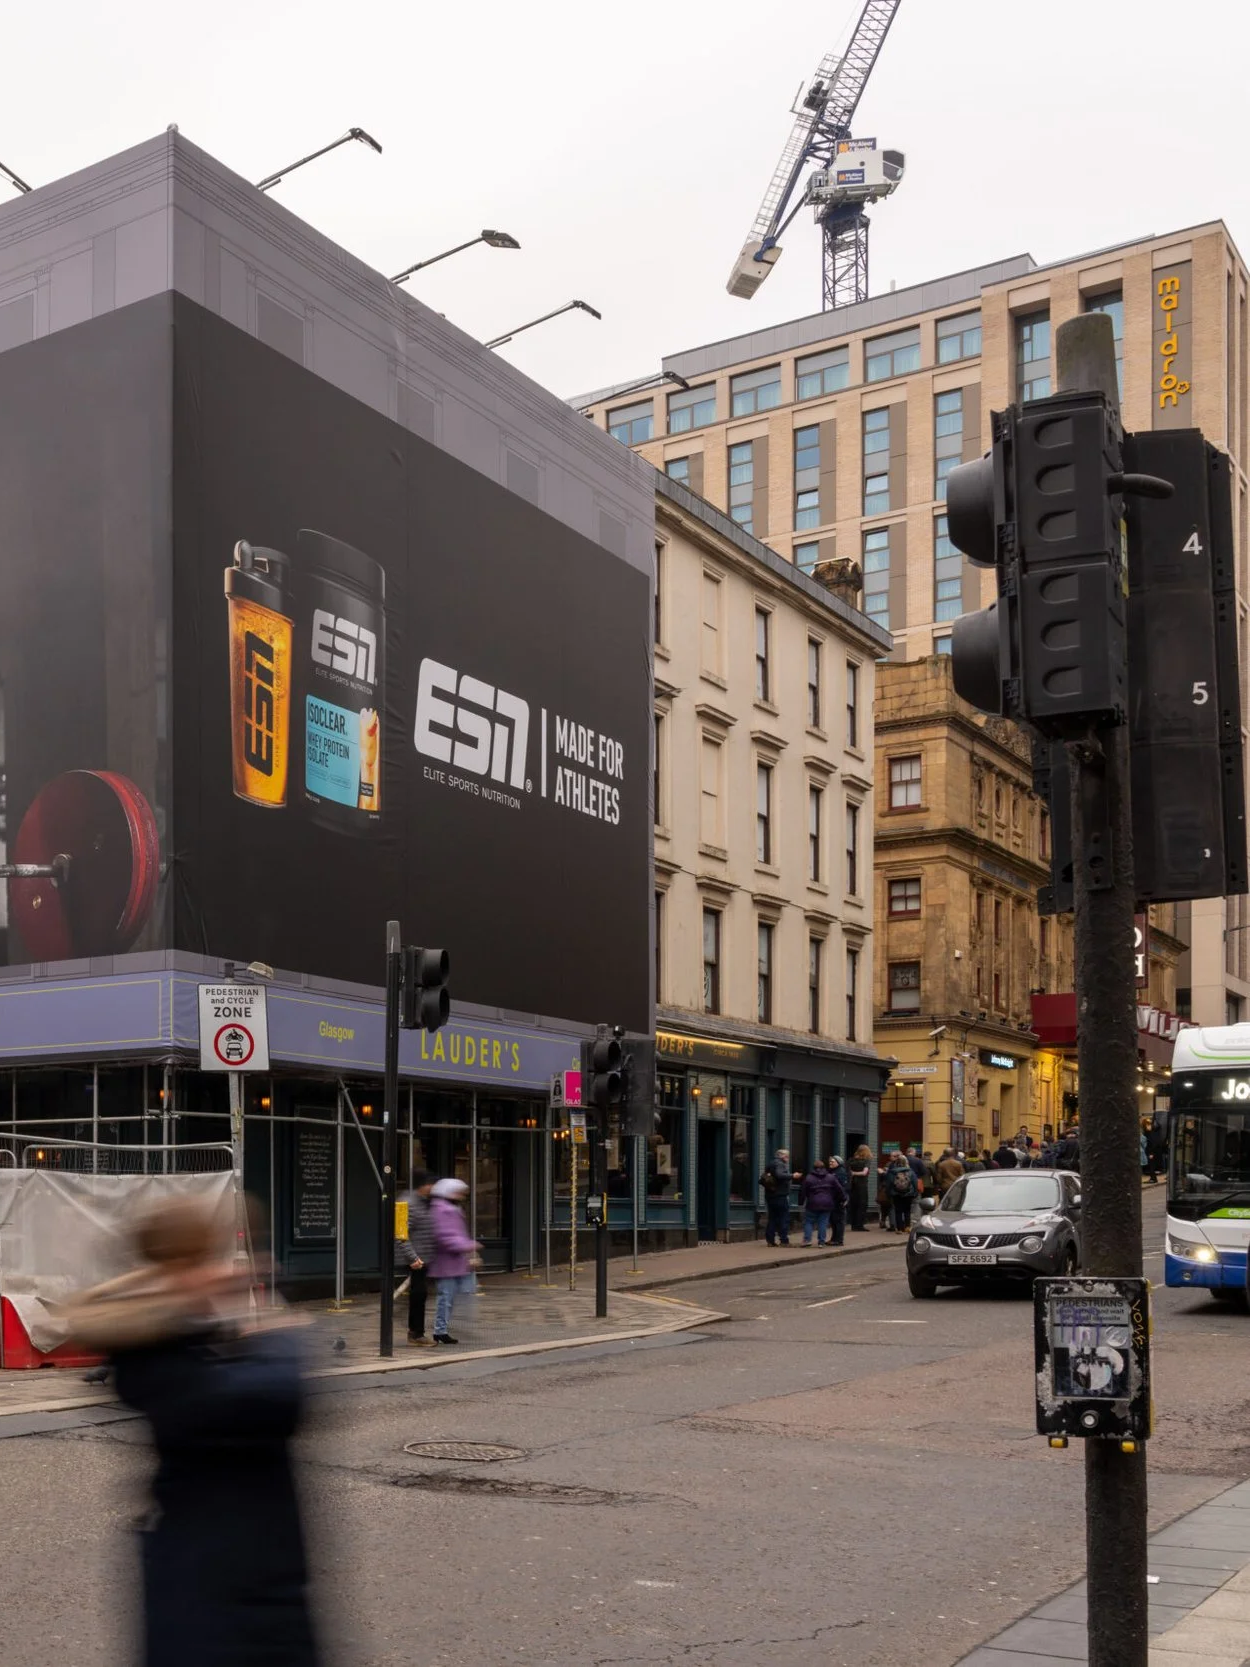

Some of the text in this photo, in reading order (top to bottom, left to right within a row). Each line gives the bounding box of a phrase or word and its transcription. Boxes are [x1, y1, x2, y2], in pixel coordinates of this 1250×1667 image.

[1158, 276, 1180, 409] maldron
[1182, 532, 1203, 555] 4
[1193, 681, 1209, 705] 5
[308, 730, 350, 760] WHEY PROTEIN
[308, 746, 329, 768] ISOLATE
[555, 715, 624, 780] MADE FOR
[423, 766, 521, 809] ELITE SPORTS NUTRITION
[554, 765, 620, 825] ATHLETES
[205, 988, 259, 996] PEDESTRIAN
[214, 1007, 252, 1018] ZONE
[319, 1021, 355, 1043] Glasgow
[421, 1028, 520, 1072] LAUDER'S
[952, 1255, 992, 1263] SFZ 5692
